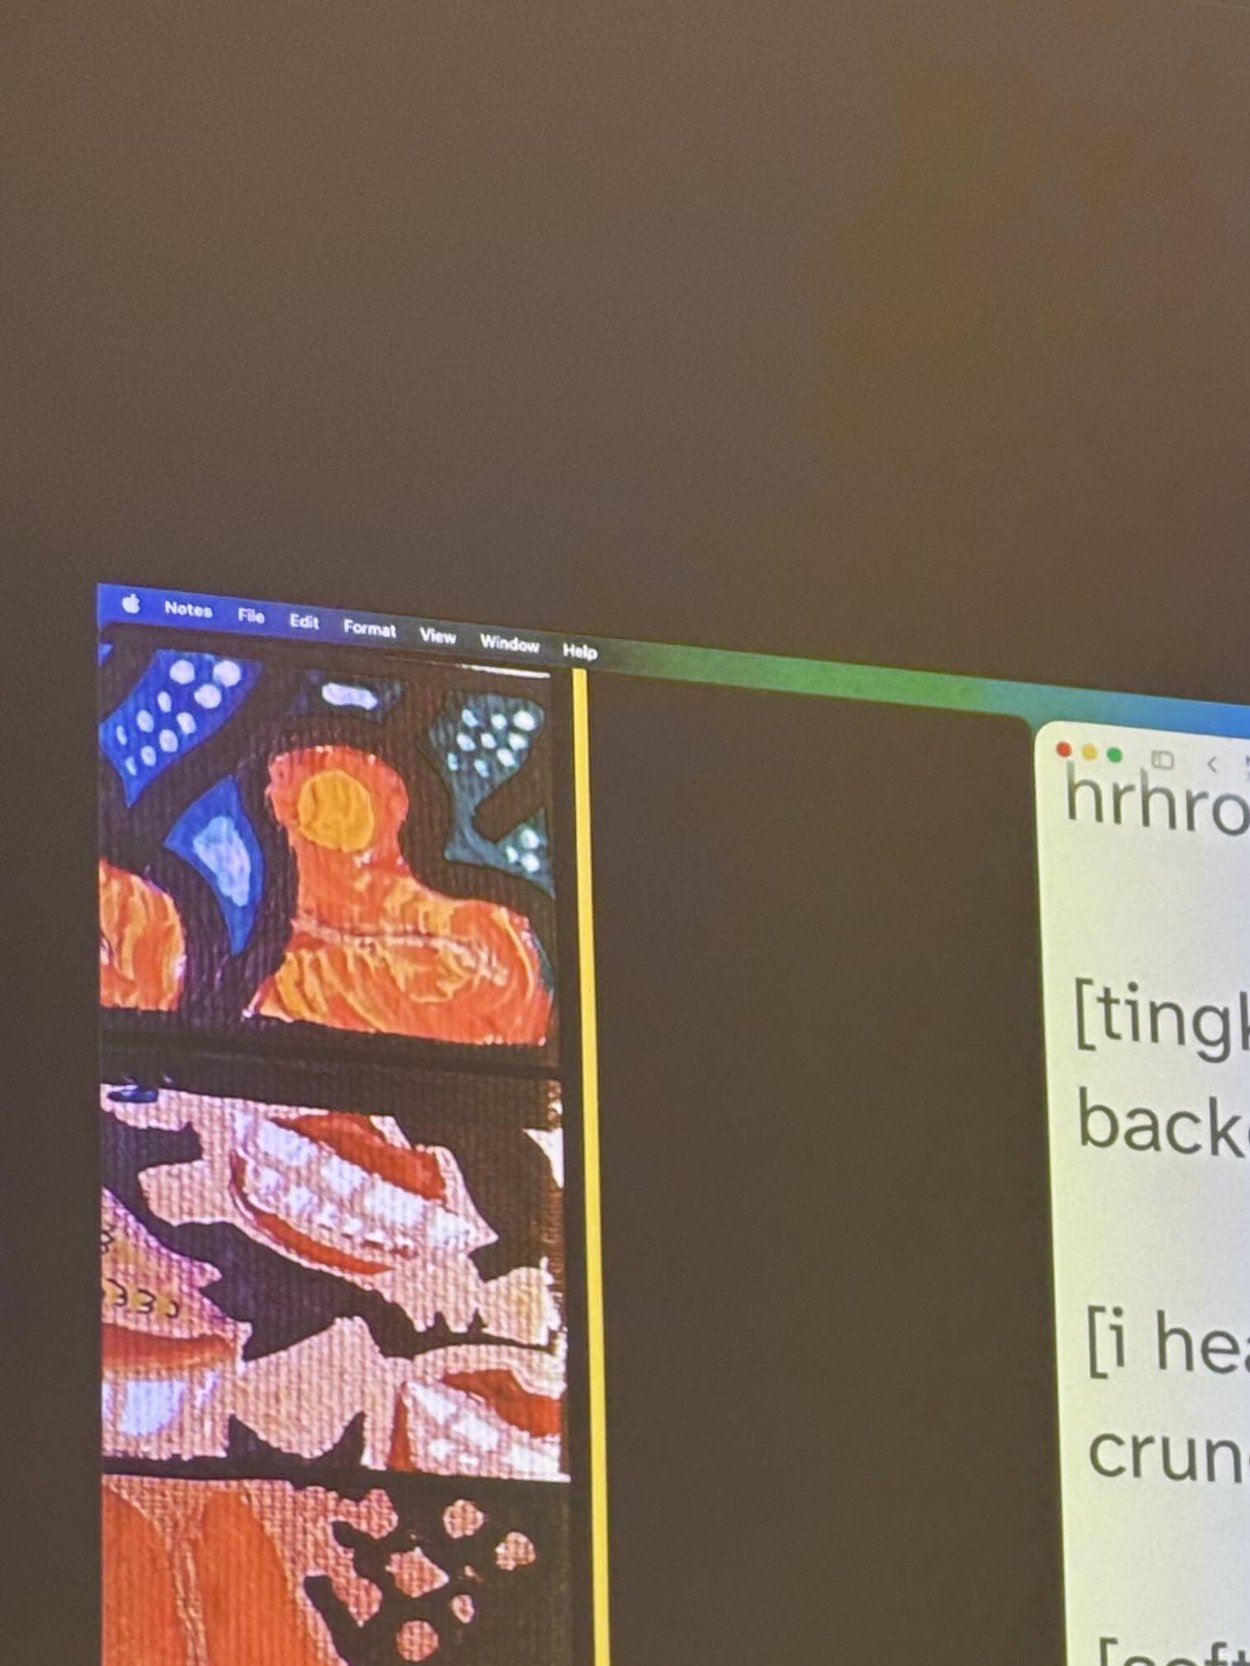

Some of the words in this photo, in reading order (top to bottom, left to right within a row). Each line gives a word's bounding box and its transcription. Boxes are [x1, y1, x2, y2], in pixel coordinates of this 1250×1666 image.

[164, 600, 213, 619] Notes
[238, 607, 265, 625] File
[289, 613, 319, 631] Edit
[344, 619, 396, 639] Format
[419, 627, 457, 646] View
[480, 633, 540, 655] Window
[563, 642, 598, 662] Help
[1087, 1305, 1126, 1380] [i
